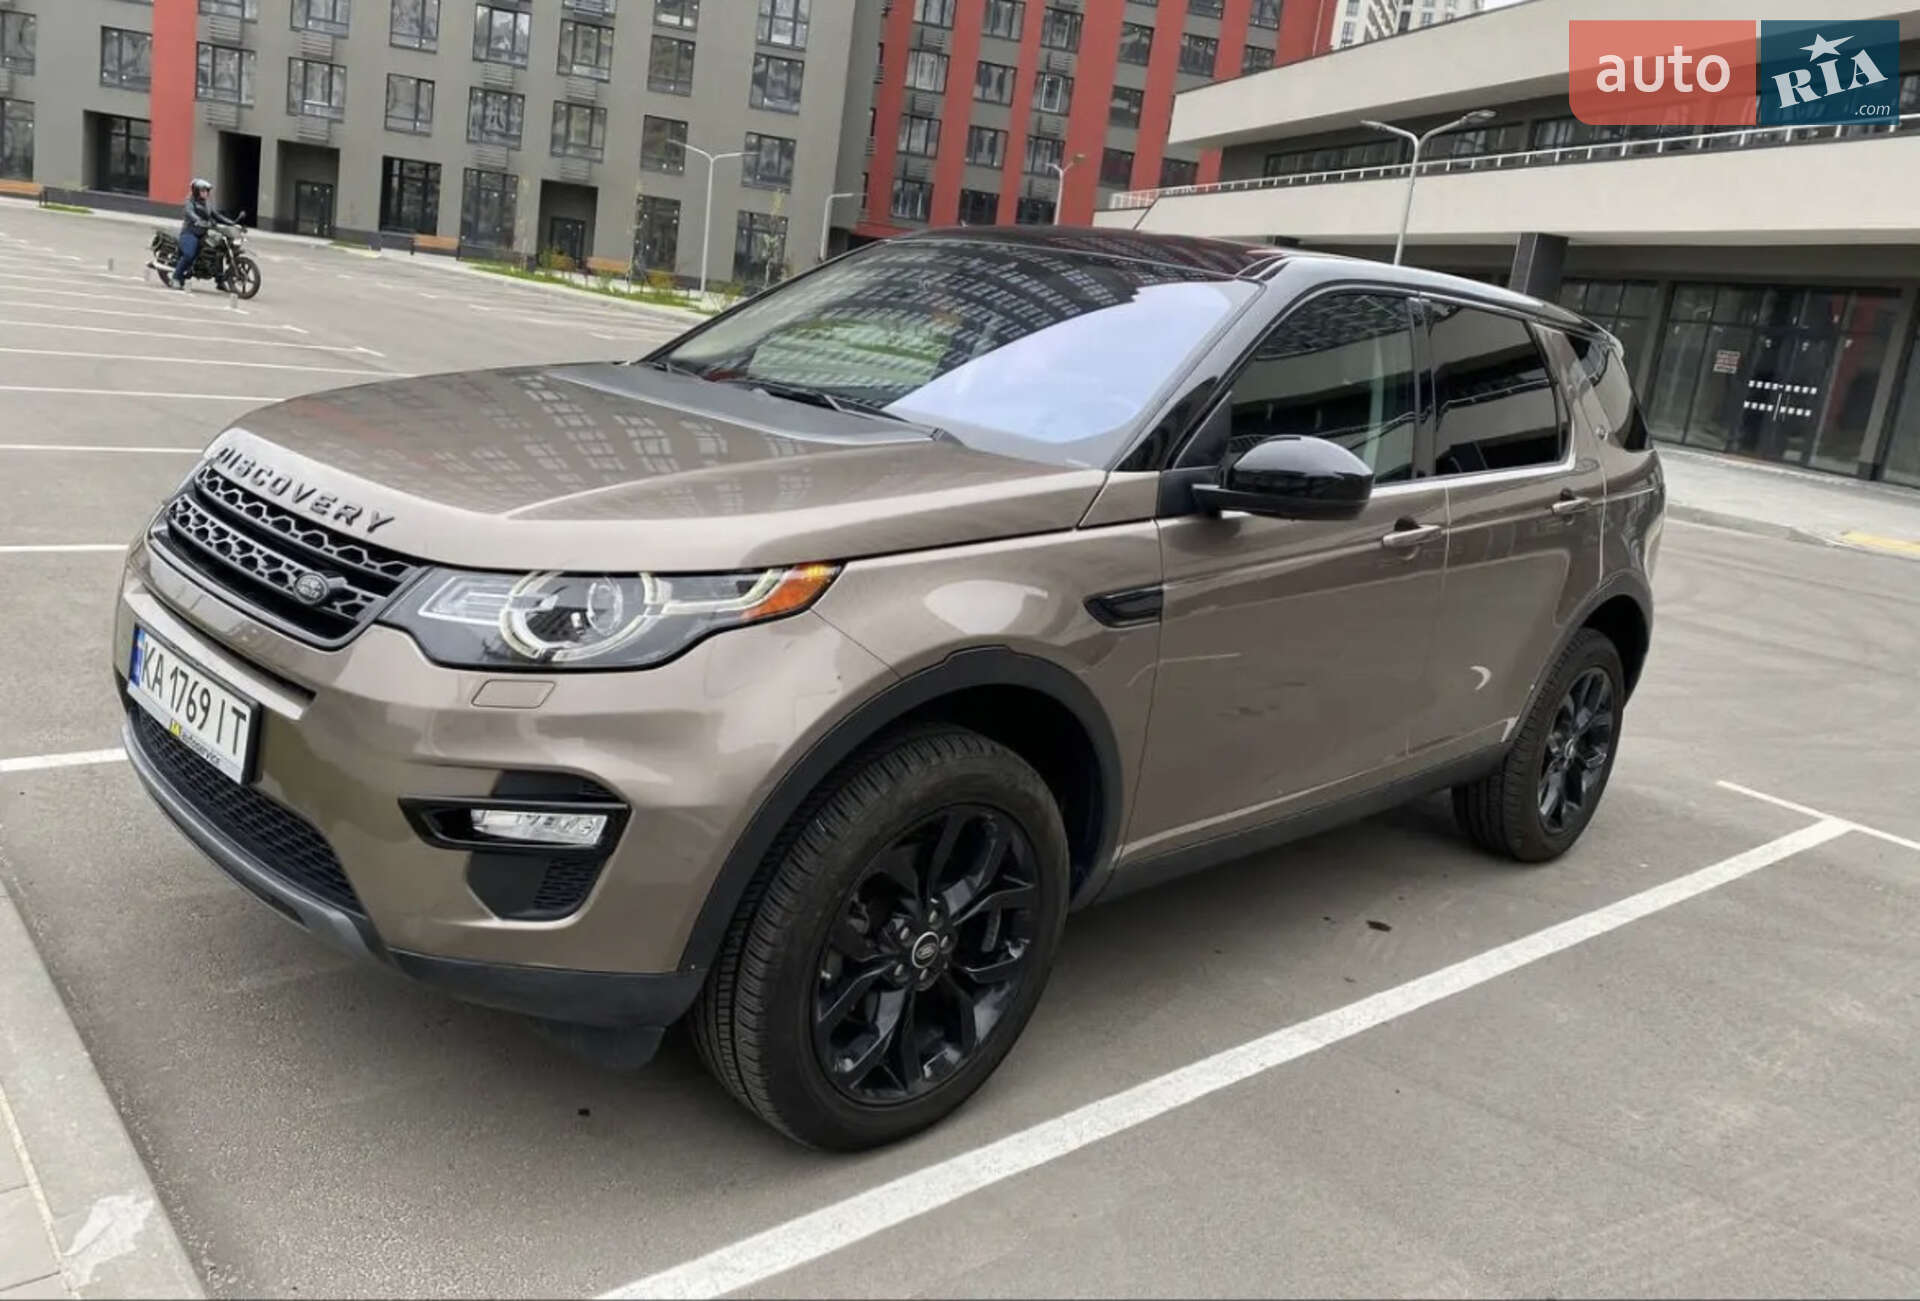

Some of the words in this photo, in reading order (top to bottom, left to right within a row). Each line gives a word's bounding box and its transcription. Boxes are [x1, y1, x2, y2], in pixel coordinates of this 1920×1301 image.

[216, 448, 395, 533] DISCOVERY
[142, 641, 164, 699] KA
[170, 666, 211, 731] 1769
[216, 699, 247, 755] IT
